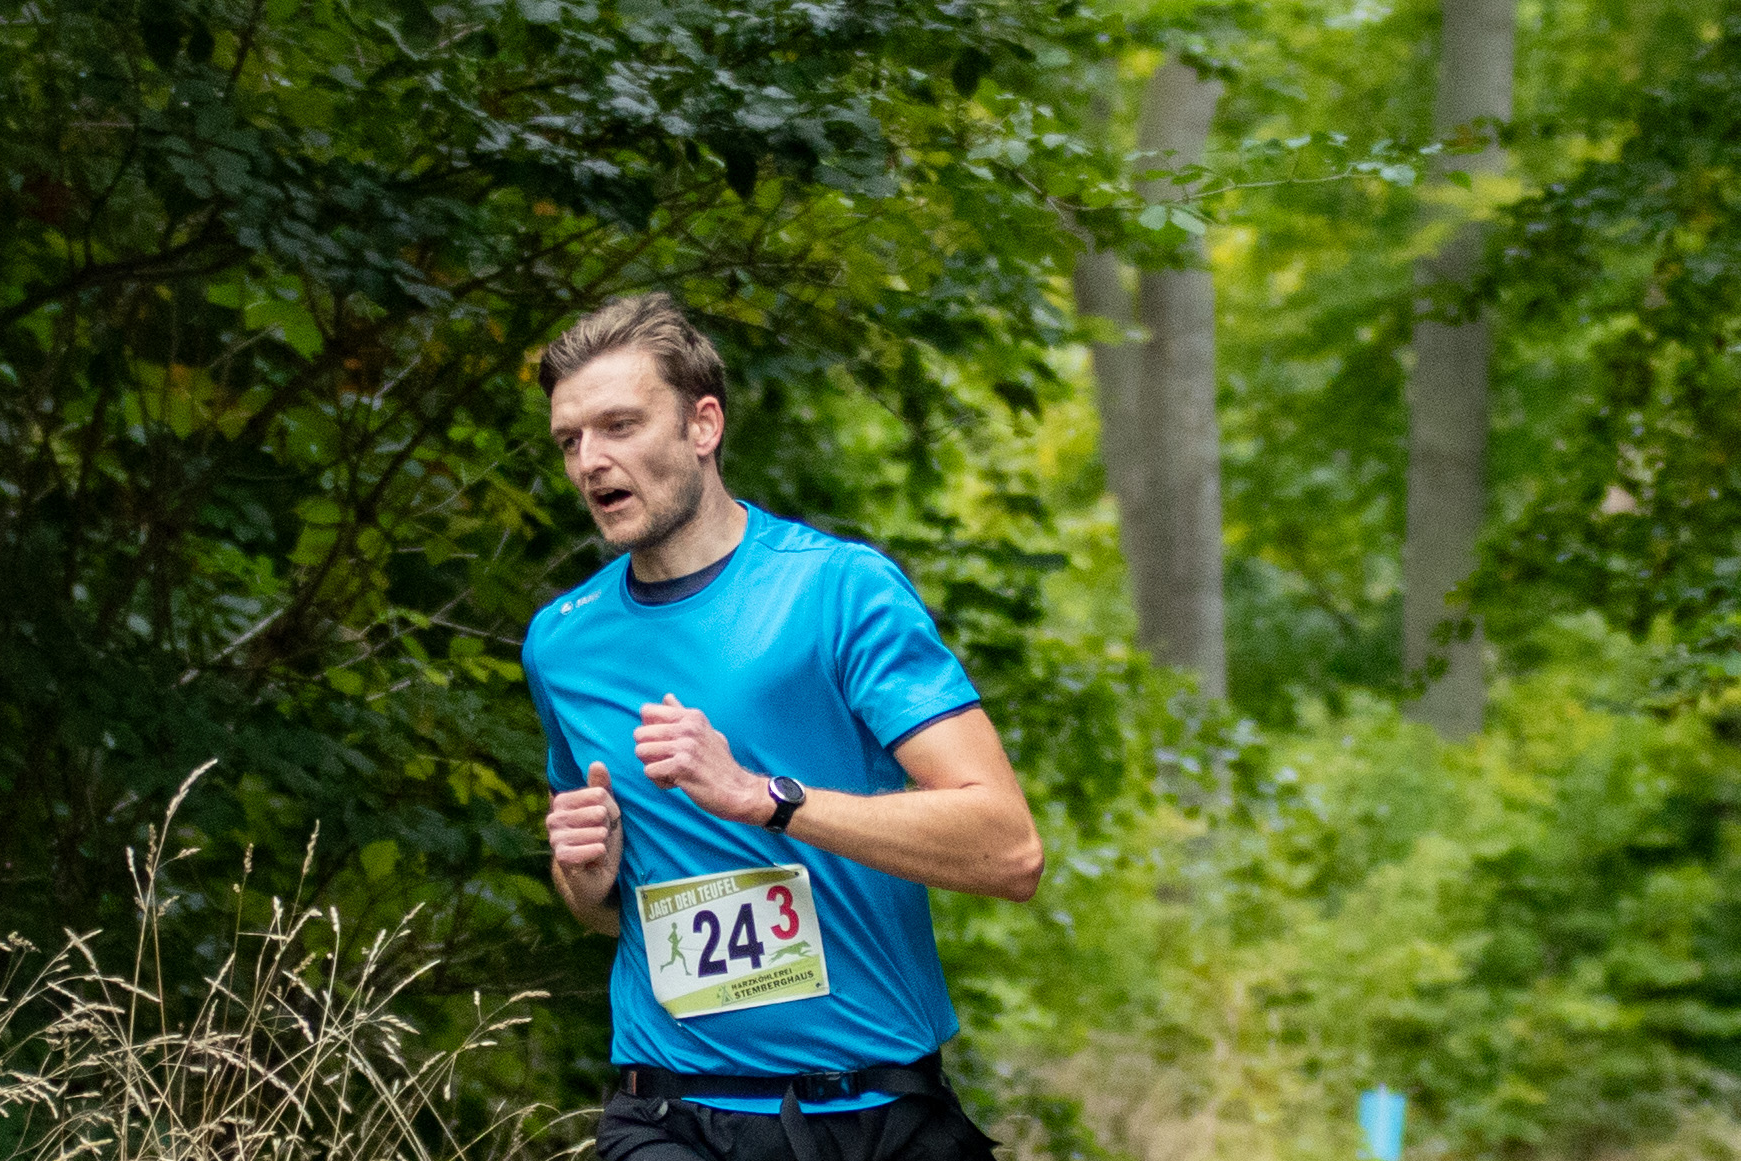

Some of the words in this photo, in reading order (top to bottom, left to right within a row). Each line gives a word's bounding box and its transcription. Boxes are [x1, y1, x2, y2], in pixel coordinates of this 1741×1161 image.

[649, 897, 673, 920] JAGT
[674, 889, 698, 911] DEN
[697, 877, 740, 903] TEUFEL
[693, 903, 765, 978] 24
[766, 885, 800, 940] 3
[734, 970, 814, 999] STEMBERGHAUS
